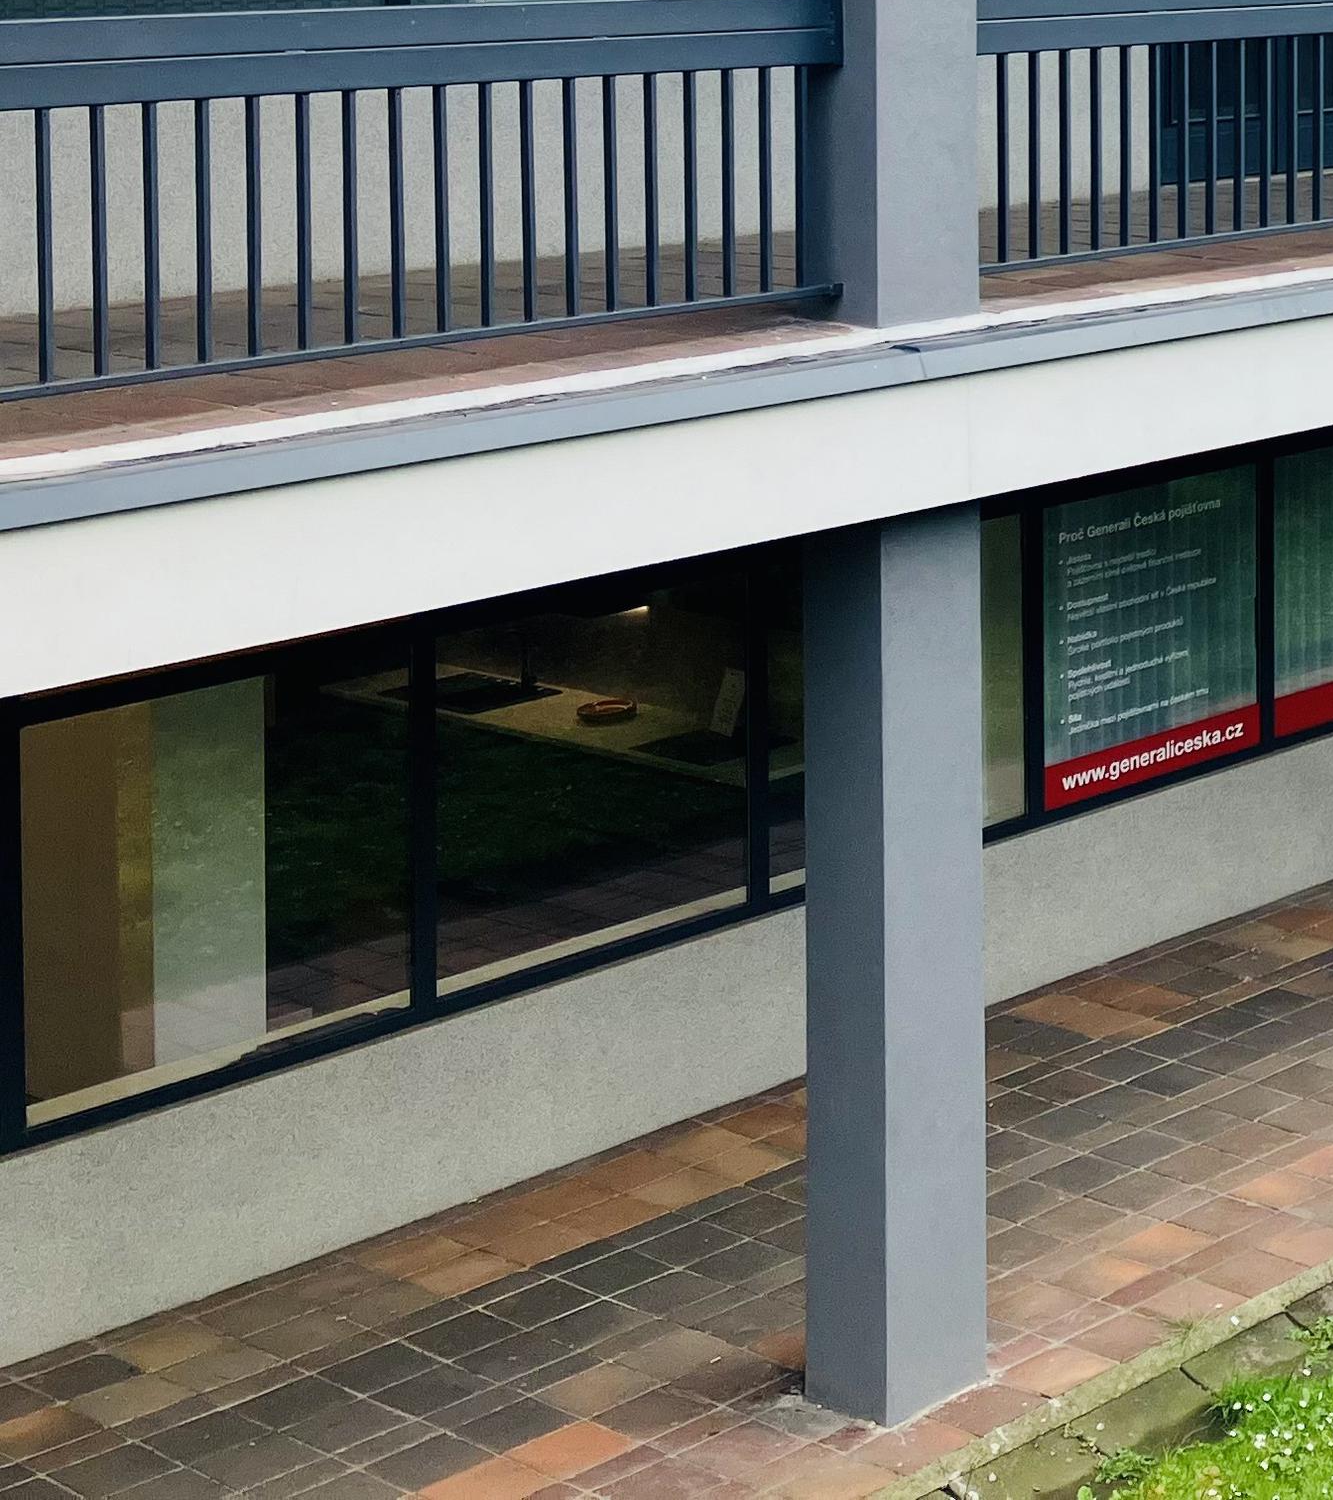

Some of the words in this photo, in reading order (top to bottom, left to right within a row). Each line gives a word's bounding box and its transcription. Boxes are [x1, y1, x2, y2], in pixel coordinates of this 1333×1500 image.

[1058, 530, 1084, 544] Proč
[1087, 519, 1131, 538] Generali
[1134, 509, 1165, 527] Česká
[1168, 499, 1221, 521] pojišťovna
[1062, 722, 1244, 791] www.generaliceska.cz
